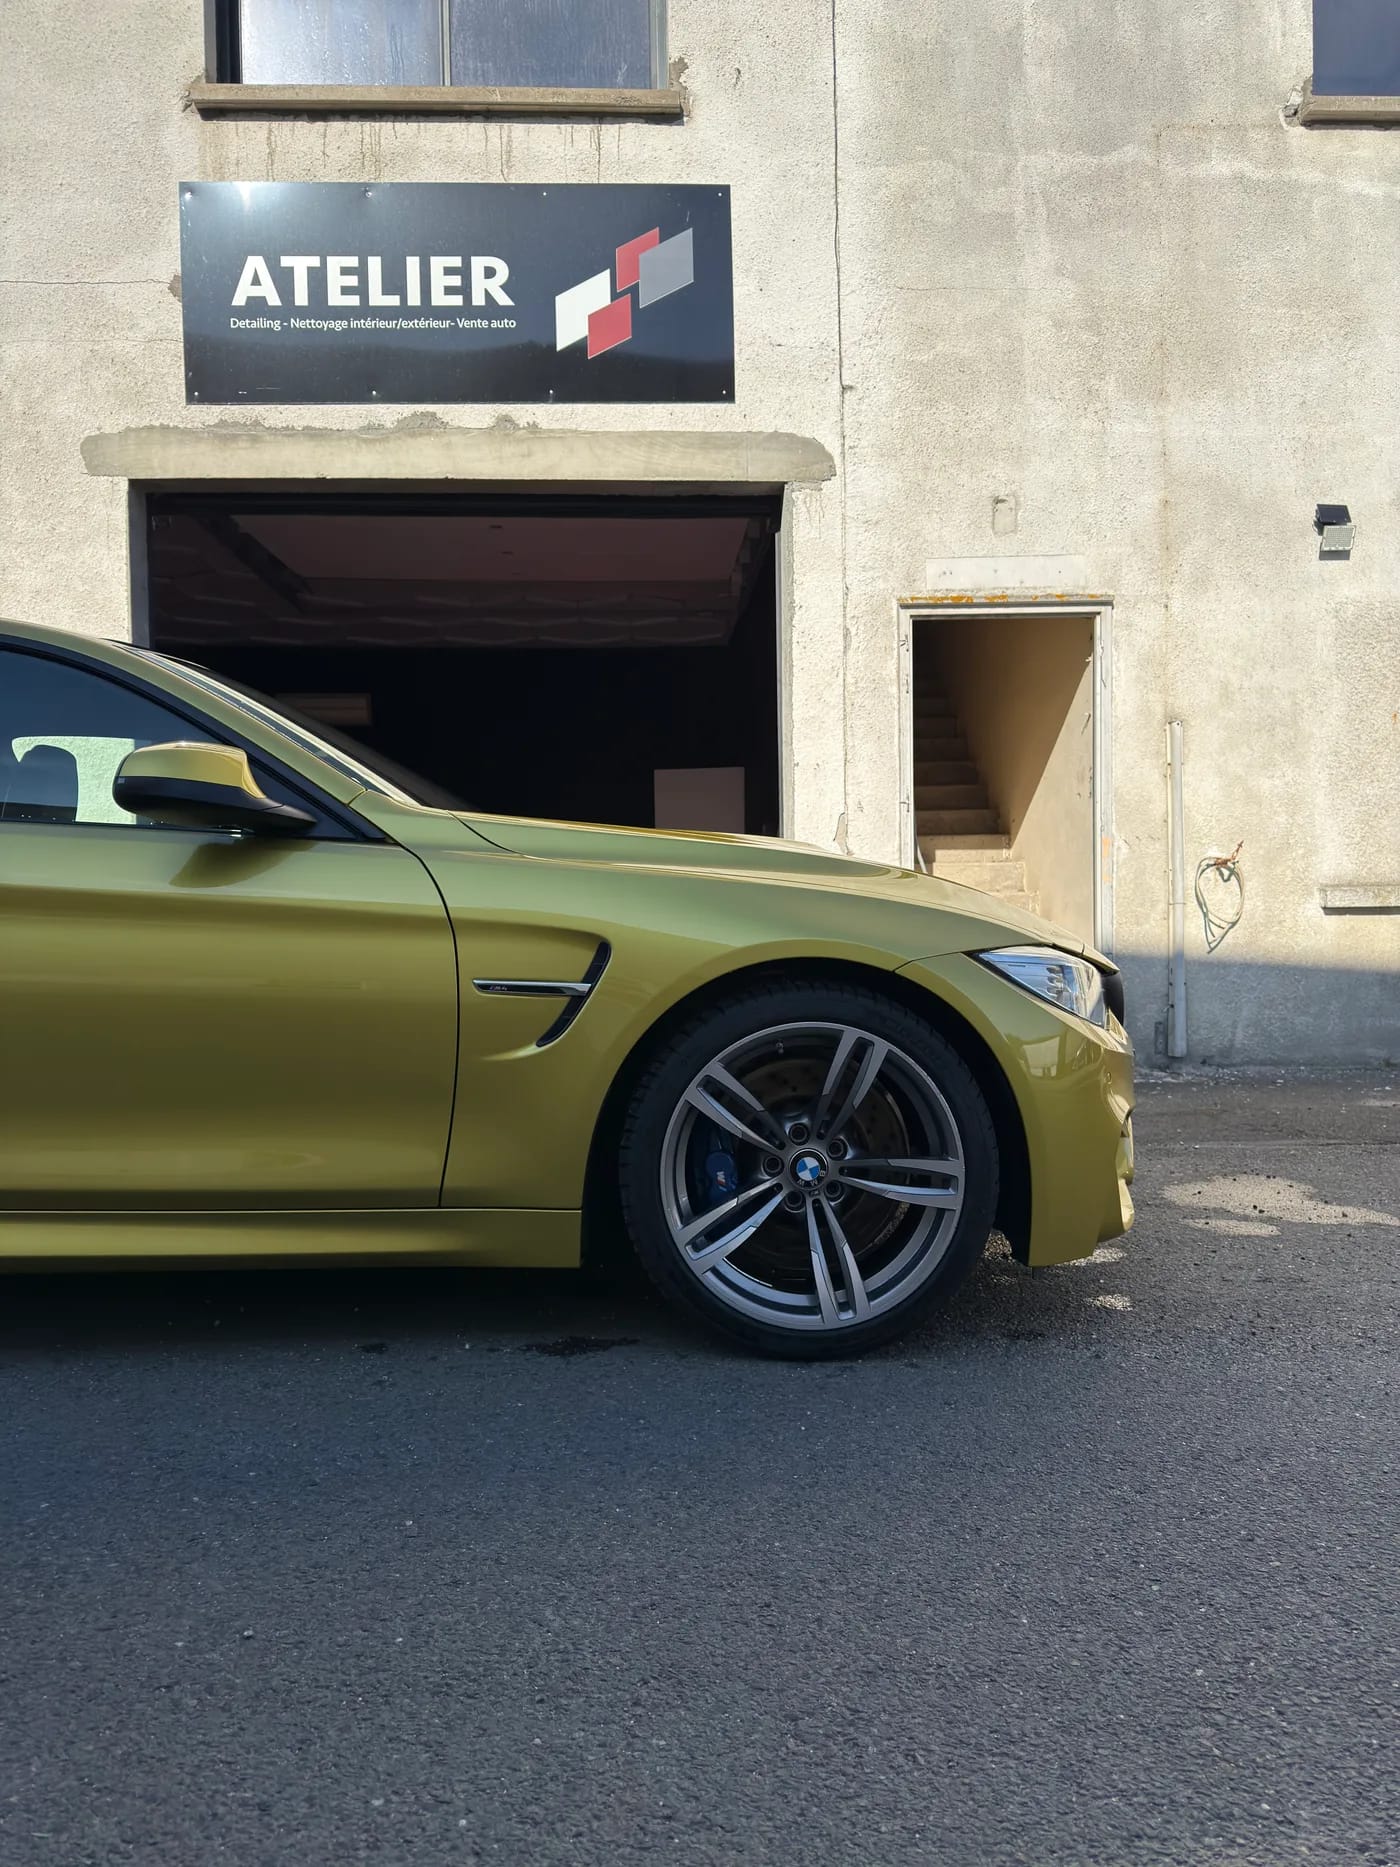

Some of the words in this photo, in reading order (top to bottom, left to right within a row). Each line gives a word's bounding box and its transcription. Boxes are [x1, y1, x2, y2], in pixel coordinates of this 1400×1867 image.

[231, 255, 515, 306] ATELIER
[229, 317, 282, 331] Detailing
[290, 317, 348, 331] Nettoyage
[456, 317, 489, 328] Vente
[490, 318, 517, 328] auto
